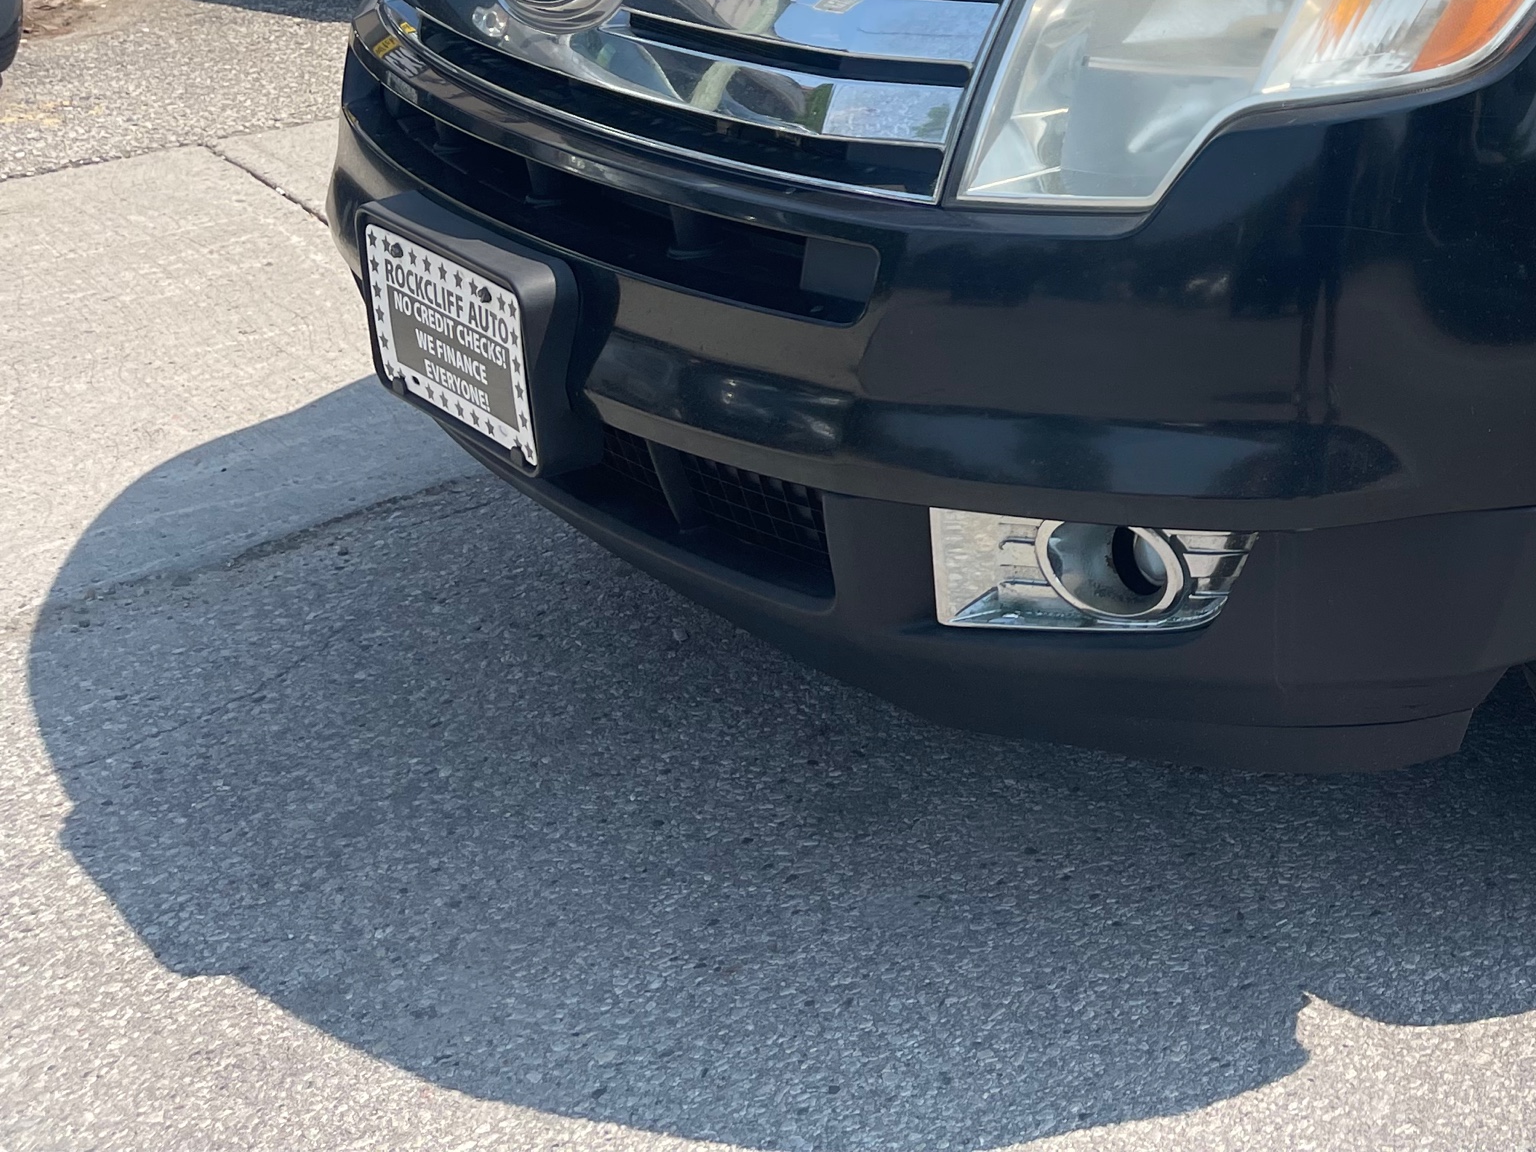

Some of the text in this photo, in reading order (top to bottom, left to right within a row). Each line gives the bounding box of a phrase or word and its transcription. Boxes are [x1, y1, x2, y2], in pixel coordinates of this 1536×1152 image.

[385, 258, 509, 345] ROCKCLIFF AUTO
[393, 291, 508, 369] NO CREDIT CHECKS!
[415, 328, 488, 385] WE FINANCE
[424, 358, 491, 412] EVERYONE!
